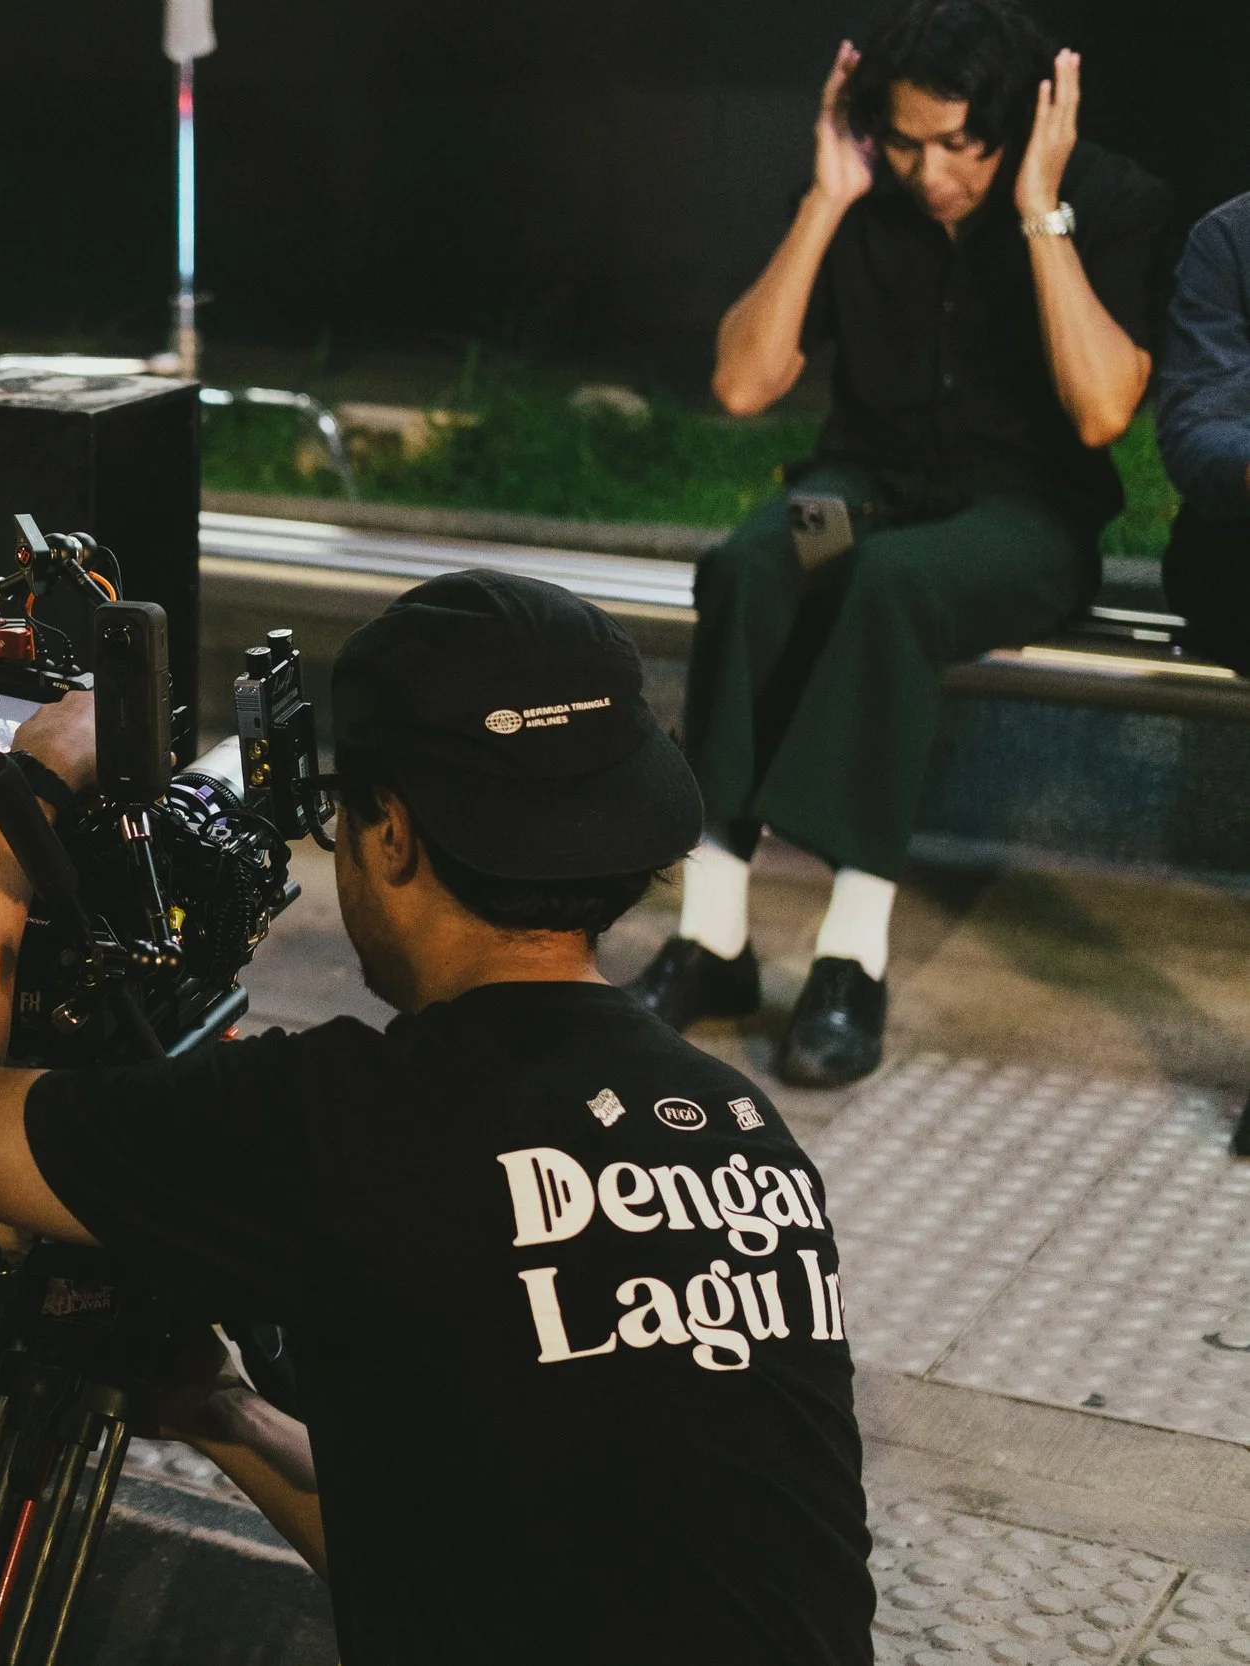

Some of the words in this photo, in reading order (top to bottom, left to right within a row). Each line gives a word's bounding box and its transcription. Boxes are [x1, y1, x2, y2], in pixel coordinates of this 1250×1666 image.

[522, 703, 571, 718] BERMUDA
[571, 697, 612, 712] TRIANGLE
[525, 715, 569, 728] AIRLINES
[517, 1259, 791, 1372] Lagu
